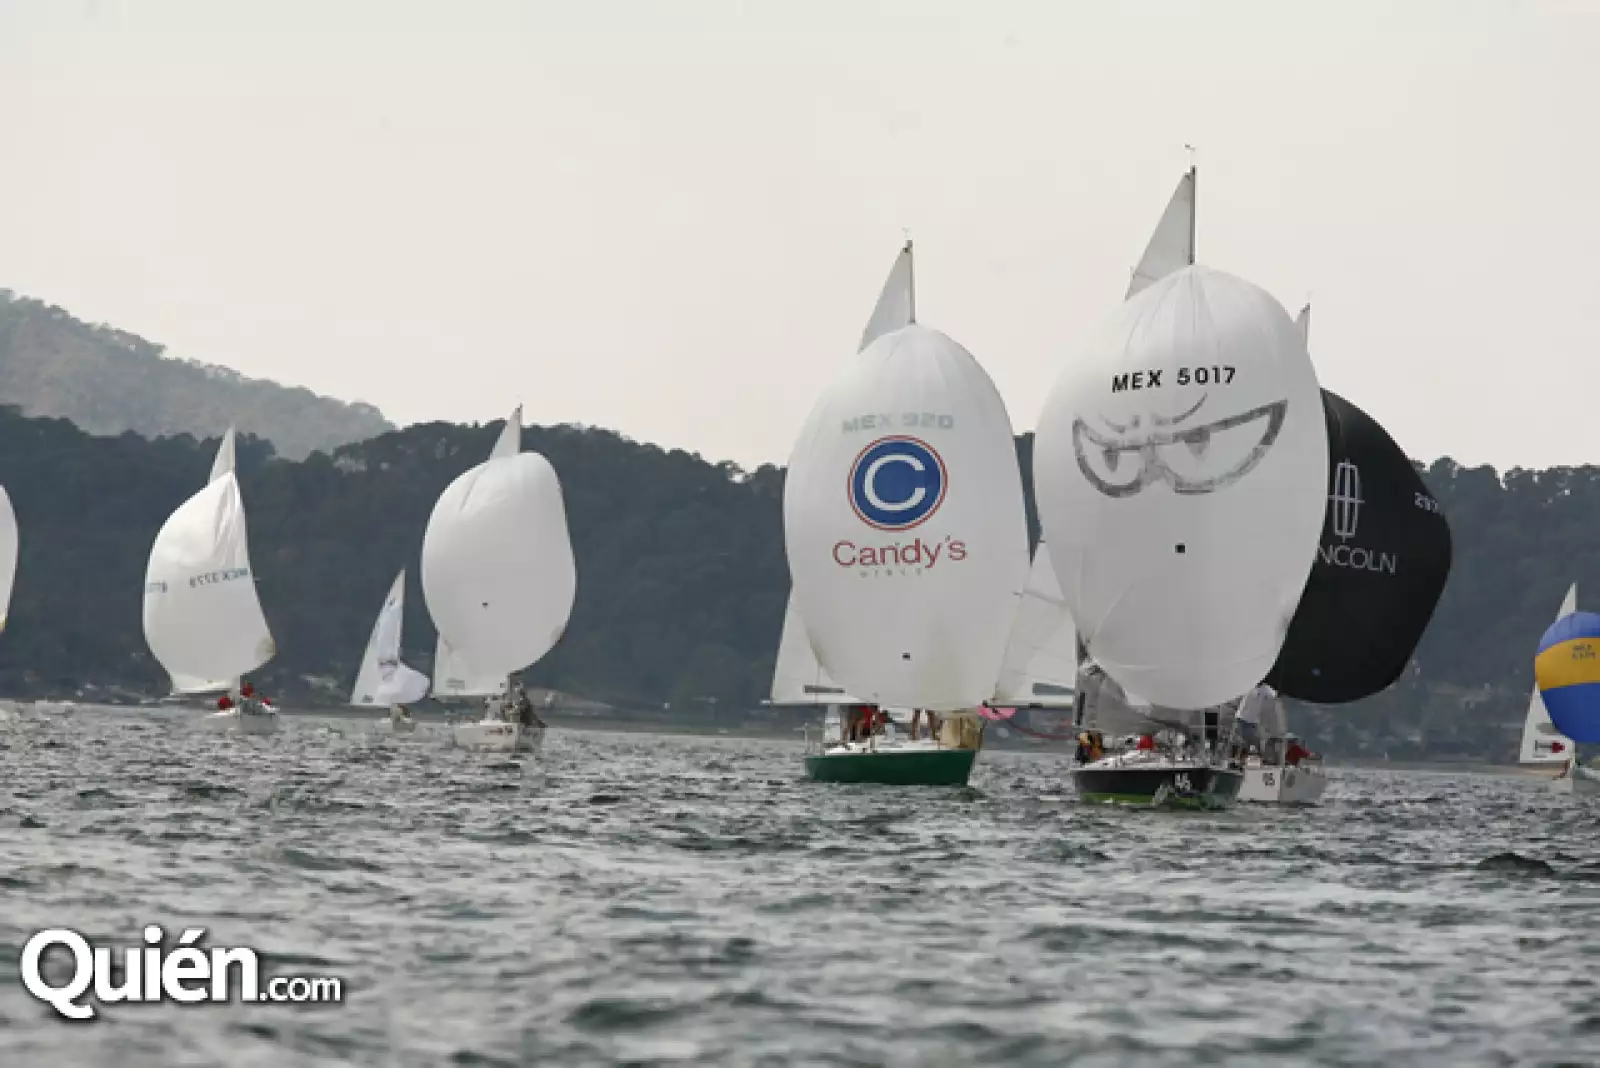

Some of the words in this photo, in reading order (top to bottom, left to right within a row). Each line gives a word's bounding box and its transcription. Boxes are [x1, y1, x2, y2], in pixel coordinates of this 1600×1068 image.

[1112, 369, 1163, 393] MEX
[1177, 365, 1236, 385] 5017
[843, 413, 890, 432] MEX
[864, 453, 925, 511] C
[832, 535, 967, 569] Candy's
